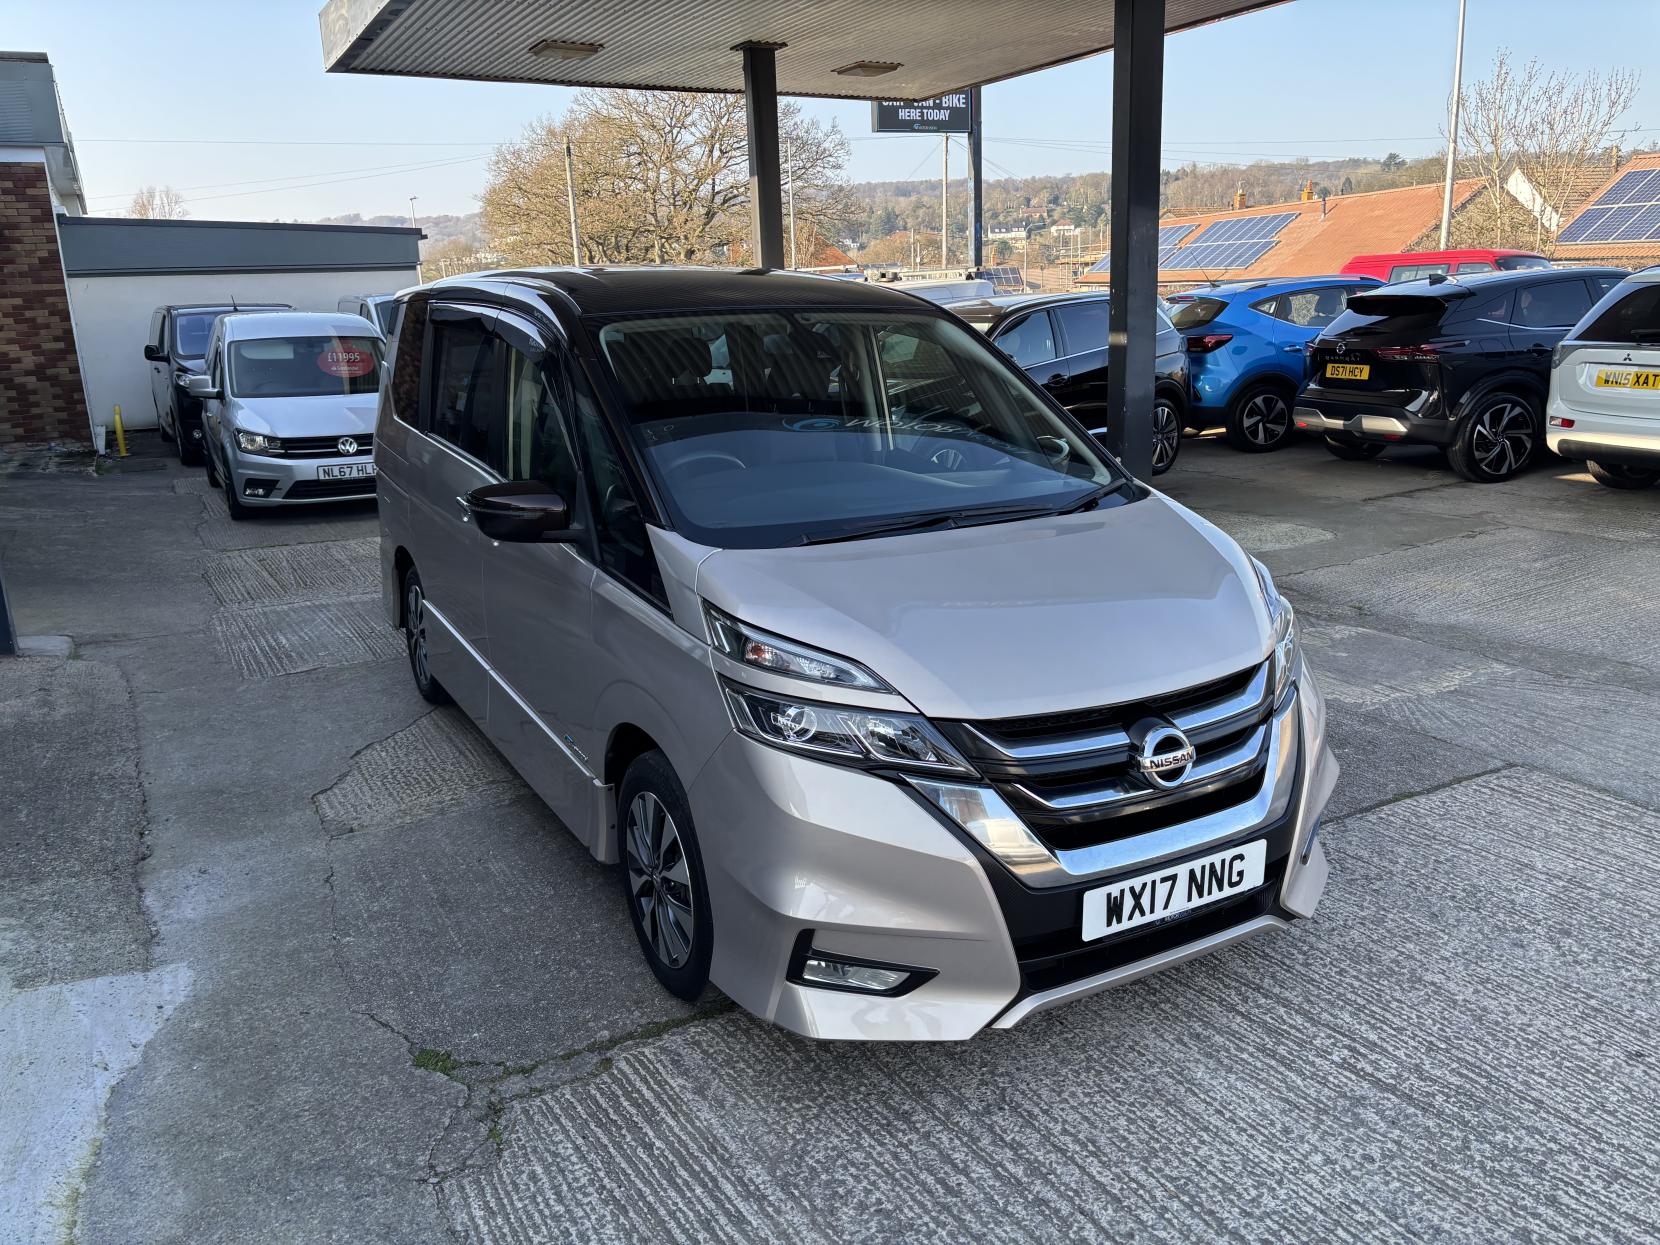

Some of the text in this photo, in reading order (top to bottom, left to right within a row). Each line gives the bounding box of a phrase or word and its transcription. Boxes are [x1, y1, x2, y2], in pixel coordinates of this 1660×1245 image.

[942, 94, 966, 108] BIKE
[899, 109, 950, 121] HERE TODAY
[328, 352, 360, 362] £11995
[1330, 365, 1348, 376] DS71
[1604, 371, 1660, 388] WN15 XAT
[322, 465, 353, 478] NL67
[1150, 751, 1193, 769] NISSAN
[1106, 853, 1246, 928] WX17 NNG
